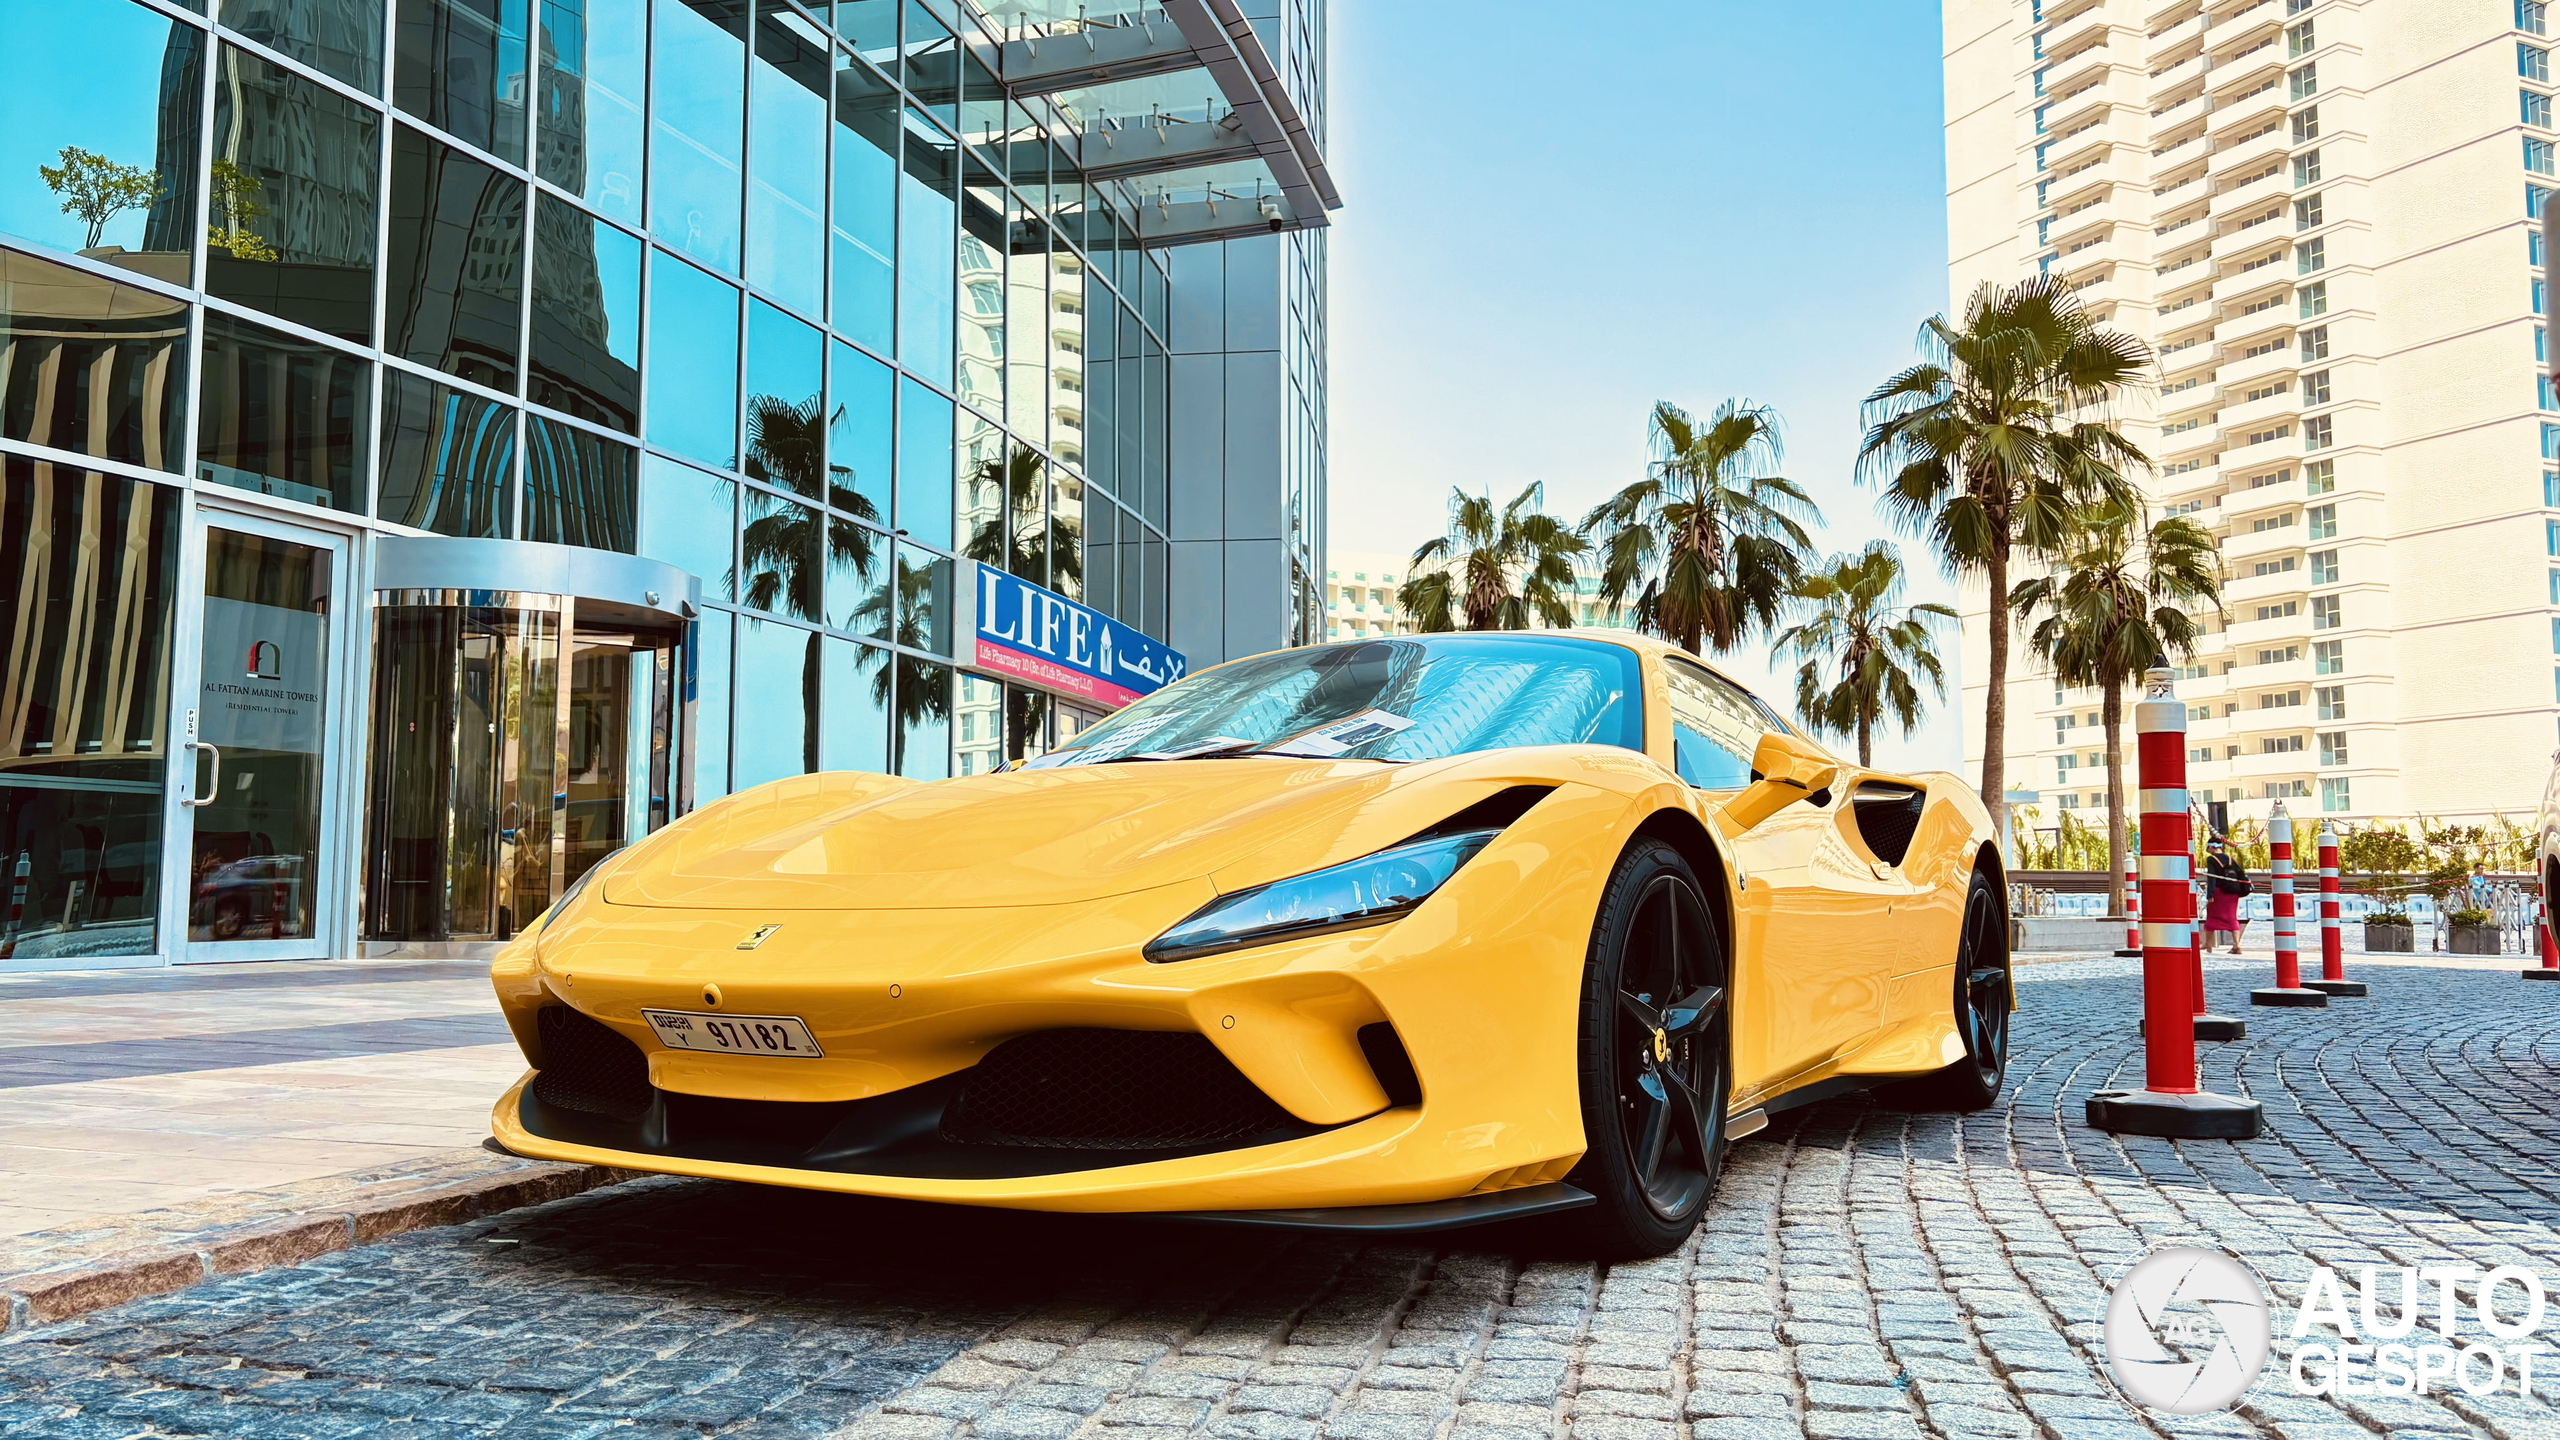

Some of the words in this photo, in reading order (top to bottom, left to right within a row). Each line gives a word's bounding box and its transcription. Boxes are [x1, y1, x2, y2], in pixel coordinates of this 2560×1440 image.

[980, 569, 1093, 668] LIFE
[980, 645, 991, 660] Life
[992, 649, 1021, 671] Pharmacy
[1022, 658, 1029, 671] 10
[1047, 666, 1055, 680] Life
[1056, 669, 1079, 690] Pharmacy
[205, 683, 216, 691] AL
[218, 684, 250, 695] FATTAN
[252, 688, 284, 699] MARINE
[287, 691, 318, 703] TOWERS
[676, 1032, 690, 1047] Y
[706, 1021, 797, 1051] 97182
